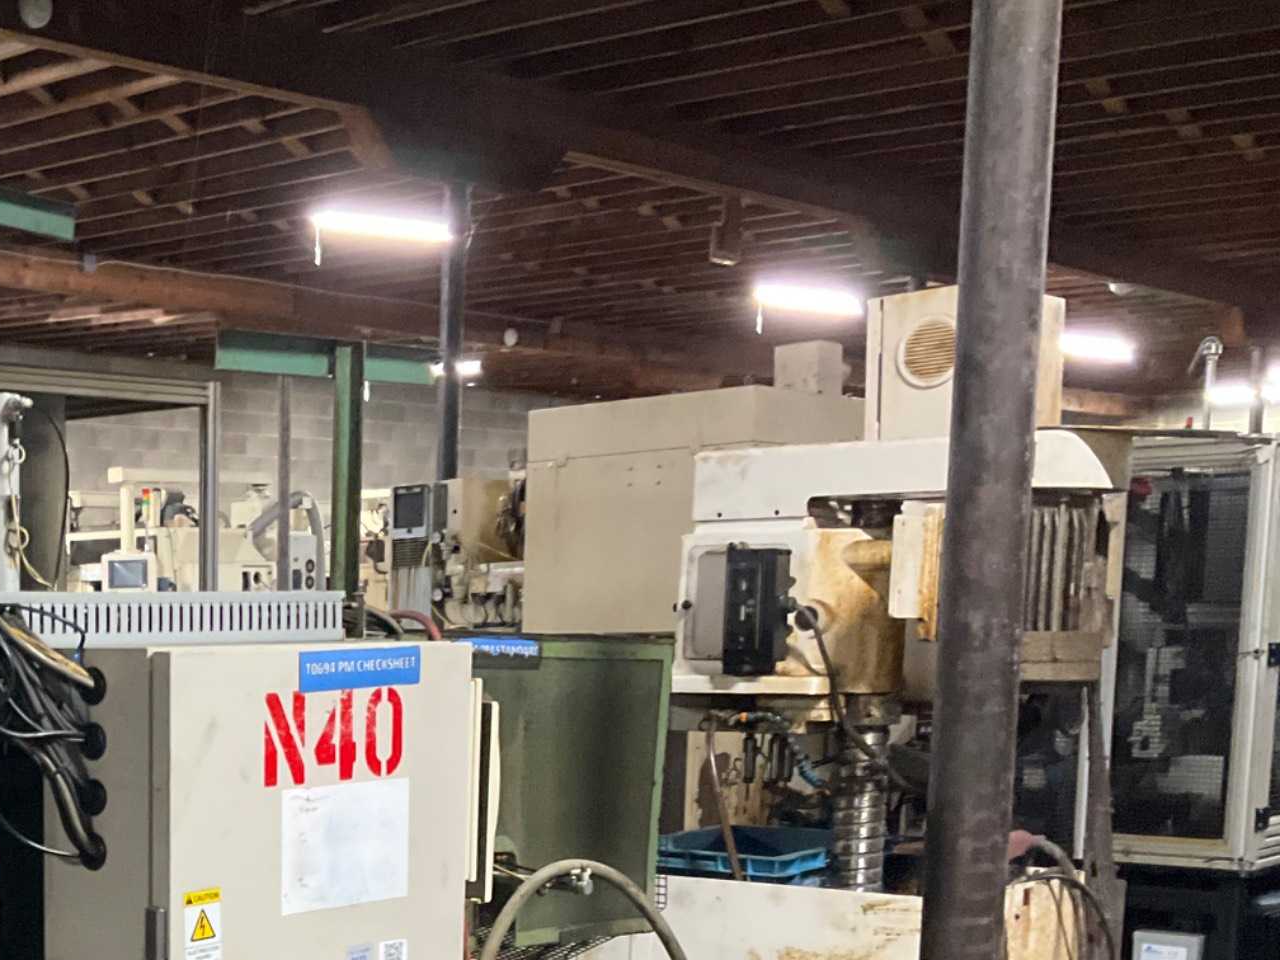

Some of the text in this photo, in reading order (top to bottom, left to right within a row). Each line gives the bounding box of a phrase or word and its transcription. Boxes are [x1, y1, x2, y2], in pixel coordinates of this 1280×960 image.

[337, 660, 355, 673] PM
[356, 655, 416, 673] CHECKSHEET
[264, 687, 403, 787] N40
